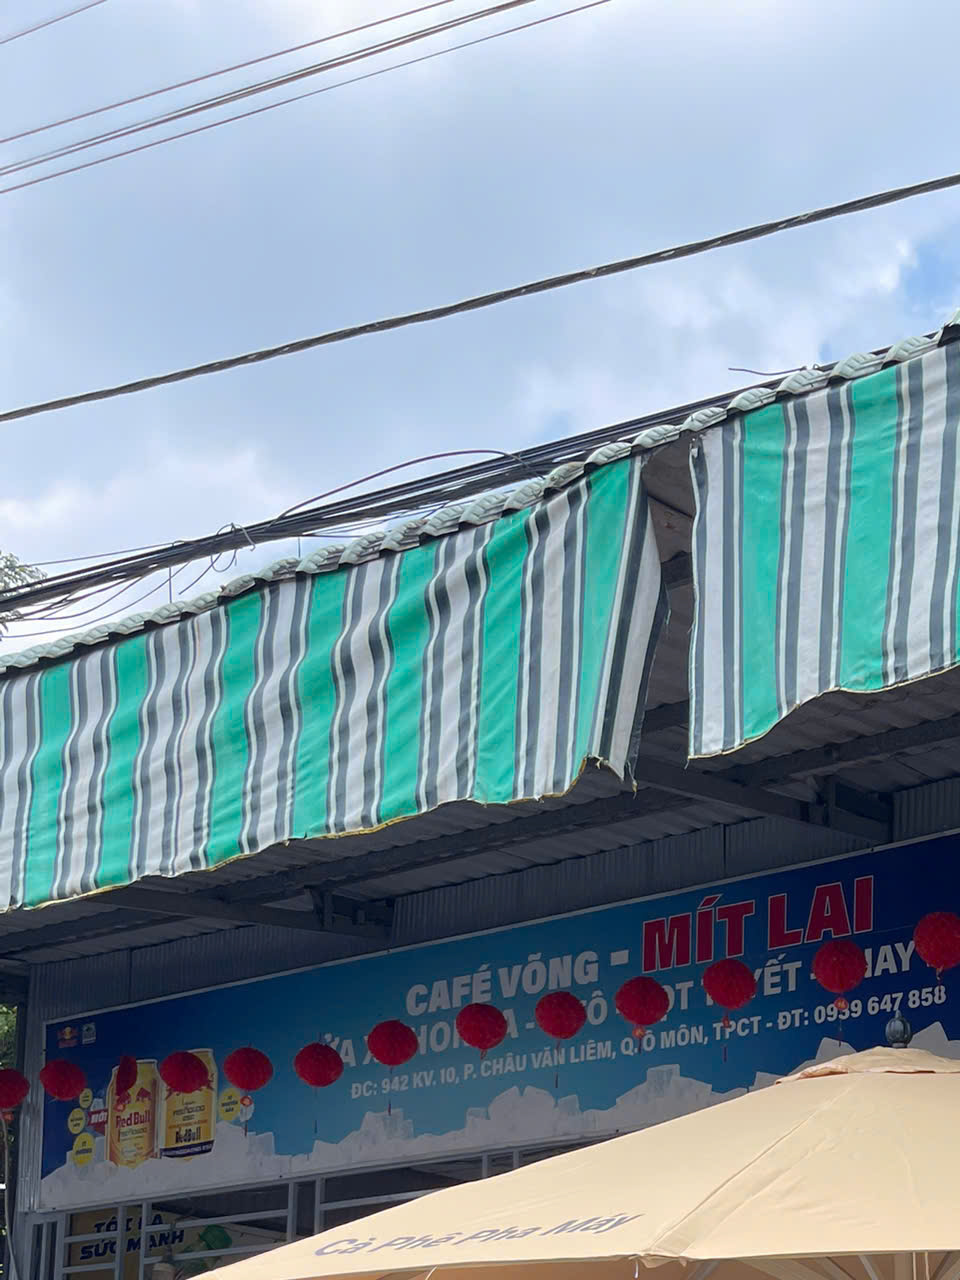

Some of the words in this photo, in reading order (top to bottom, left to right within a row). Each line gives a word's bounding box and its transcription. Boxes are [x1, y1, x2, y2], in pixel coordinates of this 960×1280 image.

[405, 963, 493, 1016] CAFÉ
[498, 951, 599, 999] VÕNG
[642, 894, 755, 973] MÍT
[768, 875, 874, 950] LAI
[351, 1081, 378, 1099] ĐC:
[381, 1076, 409, 1094] 942
[412, 1072, 437, 1089] KV.
[464, 1063, 477, 1079] P.
[480, 1052, 527, 1077] CHÂU
[530, 1048, 566, 1069] VĂN
[712, 1015, 762, 1041] TPCT
[777, 1008, 809, 1031] ĐT:
[814, 1000, 862, 1024] 0939
[867, 993, 903, 1016] 647
[908, 985, 946, 1009] 858
